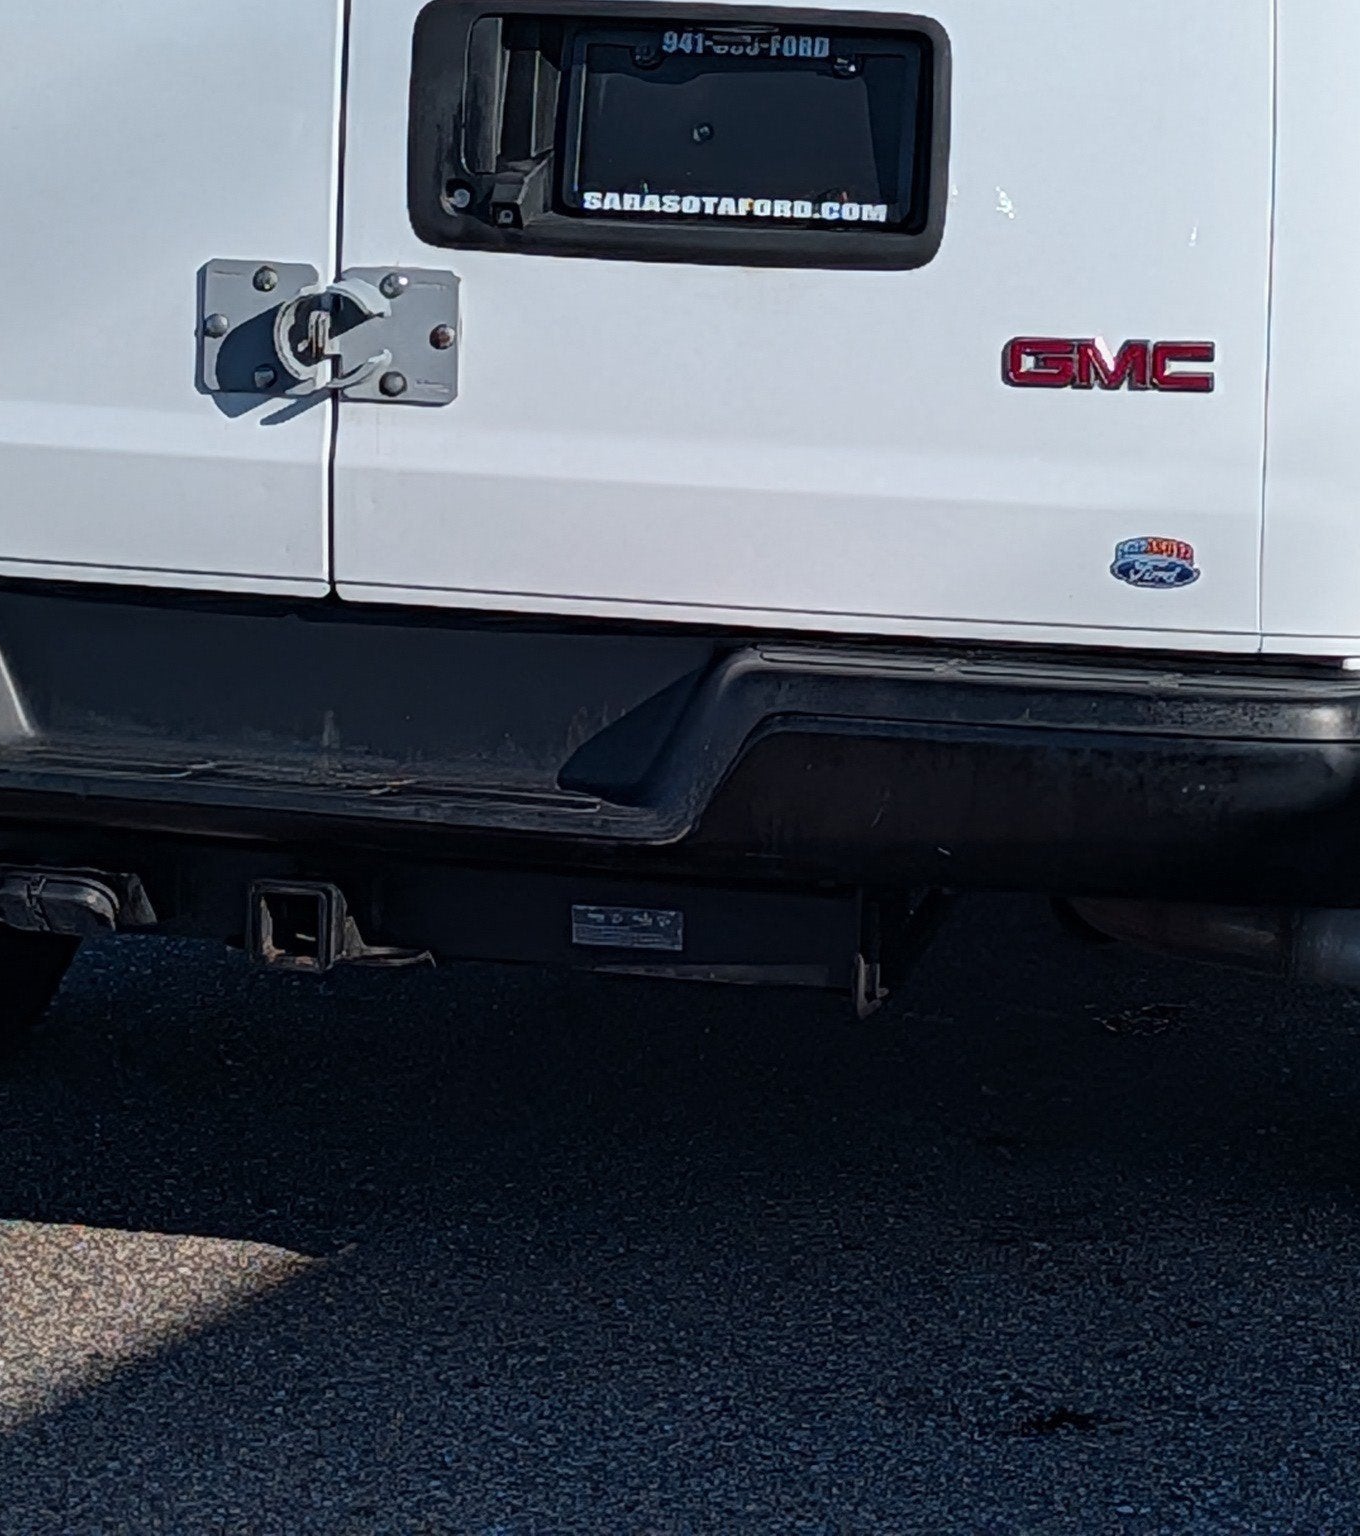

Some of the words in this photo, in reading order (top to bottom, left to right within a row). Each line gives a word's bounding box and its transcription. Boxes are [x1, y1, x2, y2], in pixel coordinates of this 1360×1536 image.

[582, 191, 888, 222] SARASOTAFORD.COM
[1000, 336, 1216, 394] GMC
[1128, 560, 1182, 583] Ford
